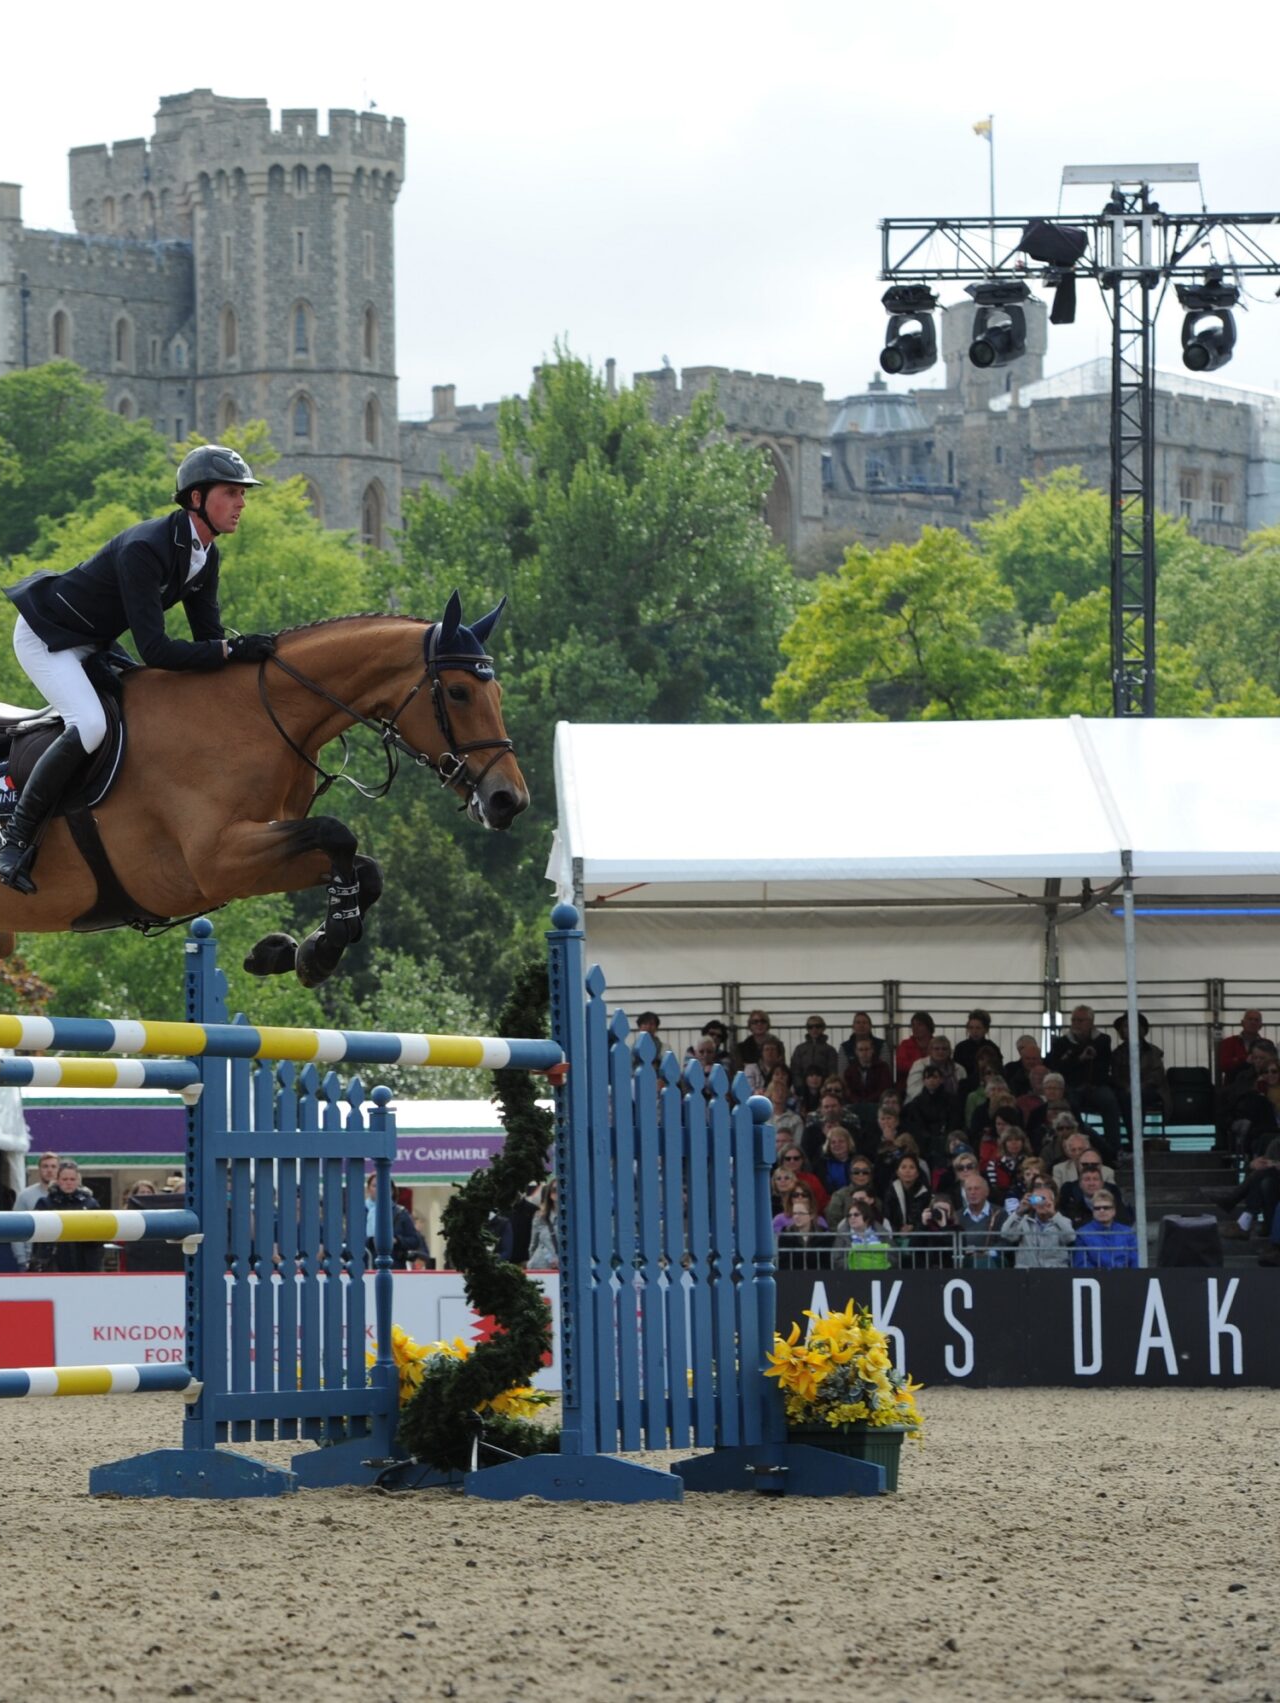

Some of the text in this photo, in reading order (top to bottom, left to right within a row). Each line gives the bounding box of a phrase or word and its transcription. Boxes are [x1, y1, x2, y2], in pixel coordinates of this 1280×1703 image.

[92, 1325, 186, 1341] KINGDOM
[1071, 1277, 1244, 1376] DAK
[144, 1347, 183, 1363] FOR
